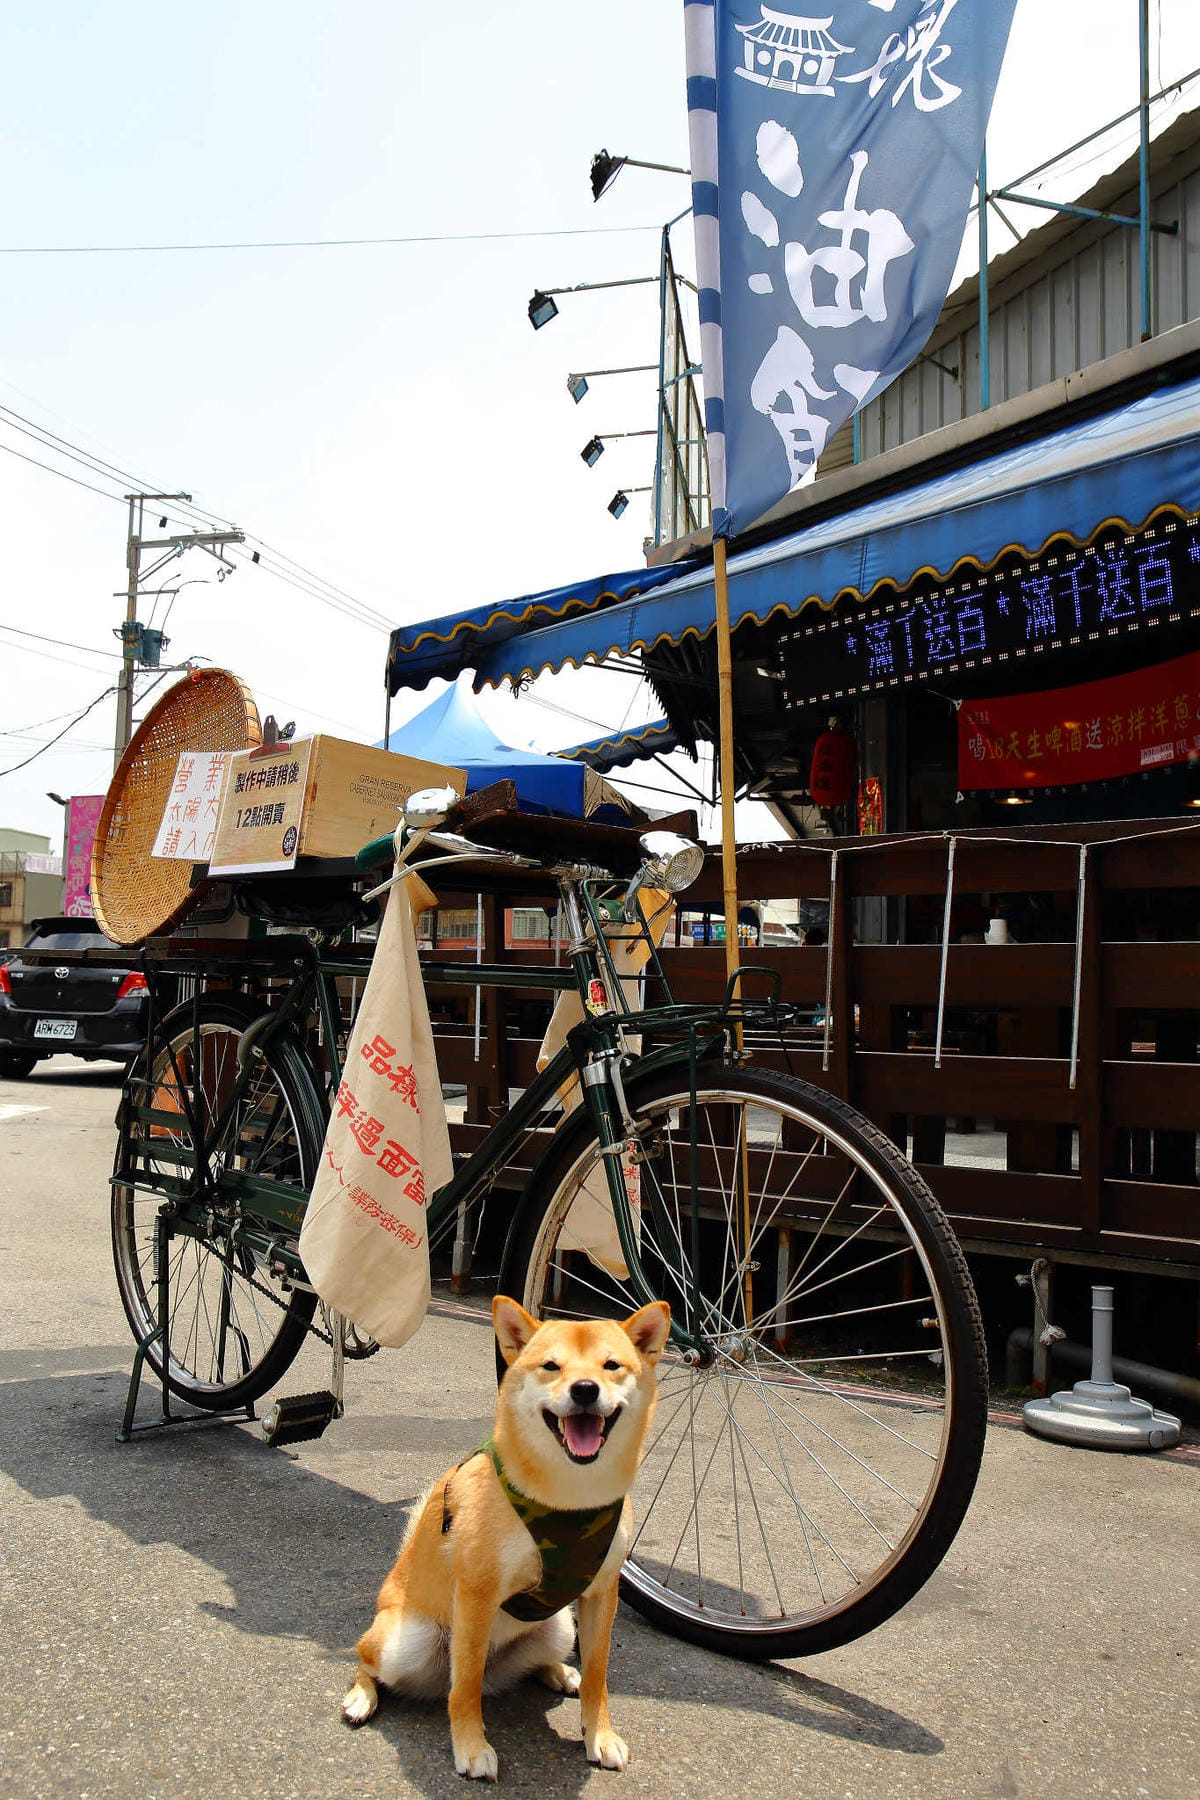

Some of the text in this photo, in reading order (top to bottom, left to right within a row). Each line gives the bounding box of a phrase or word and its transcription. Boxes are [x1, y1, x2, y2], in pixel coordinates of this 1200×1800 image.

[968, 694, 1200, 761] 喝18天生啤酒送涼拌洋蔥
[234, 761, 300, 794] 製作中請稍後
[359, 774, 412, 794] GRAN RESERVA
[235, 802, 286, 829] 12點開賣
